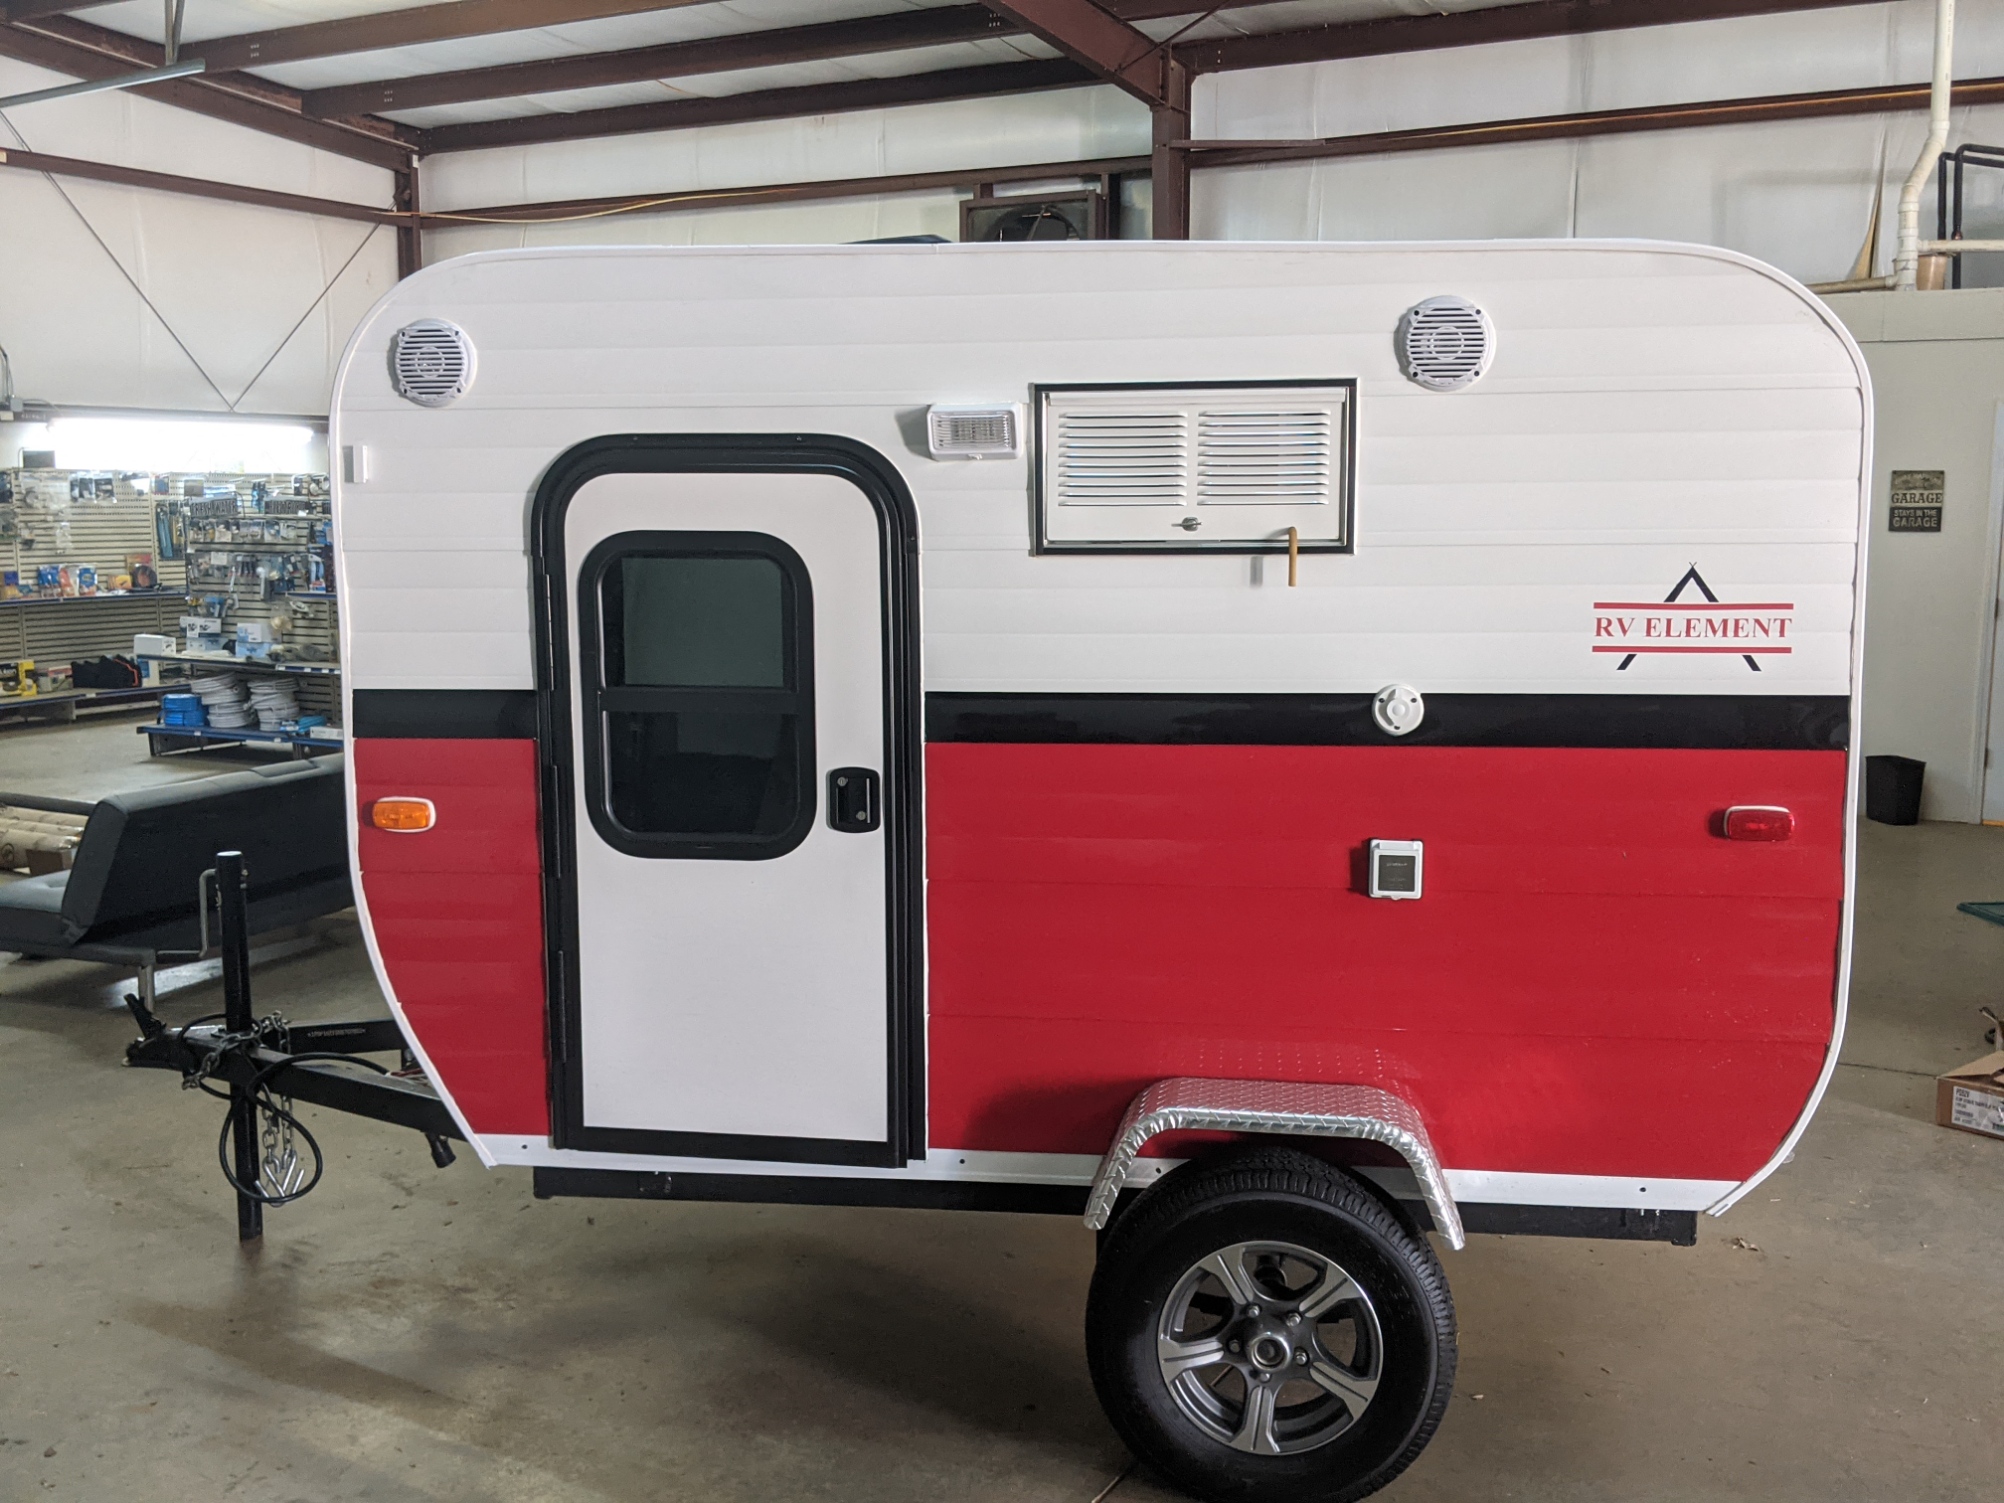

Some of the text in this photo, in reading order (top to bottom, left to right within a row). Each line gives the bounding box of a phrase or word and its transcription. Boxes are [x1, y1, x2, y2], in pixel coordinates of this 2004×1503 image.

[1891, 492, 1943, 504] GARAGE
[1893, 509, 1938, 517] STAYS IN THE
[1893, 517, 1938, 527] GARAGE
[1594, 616, 1793, 638] RV ELEMENT
